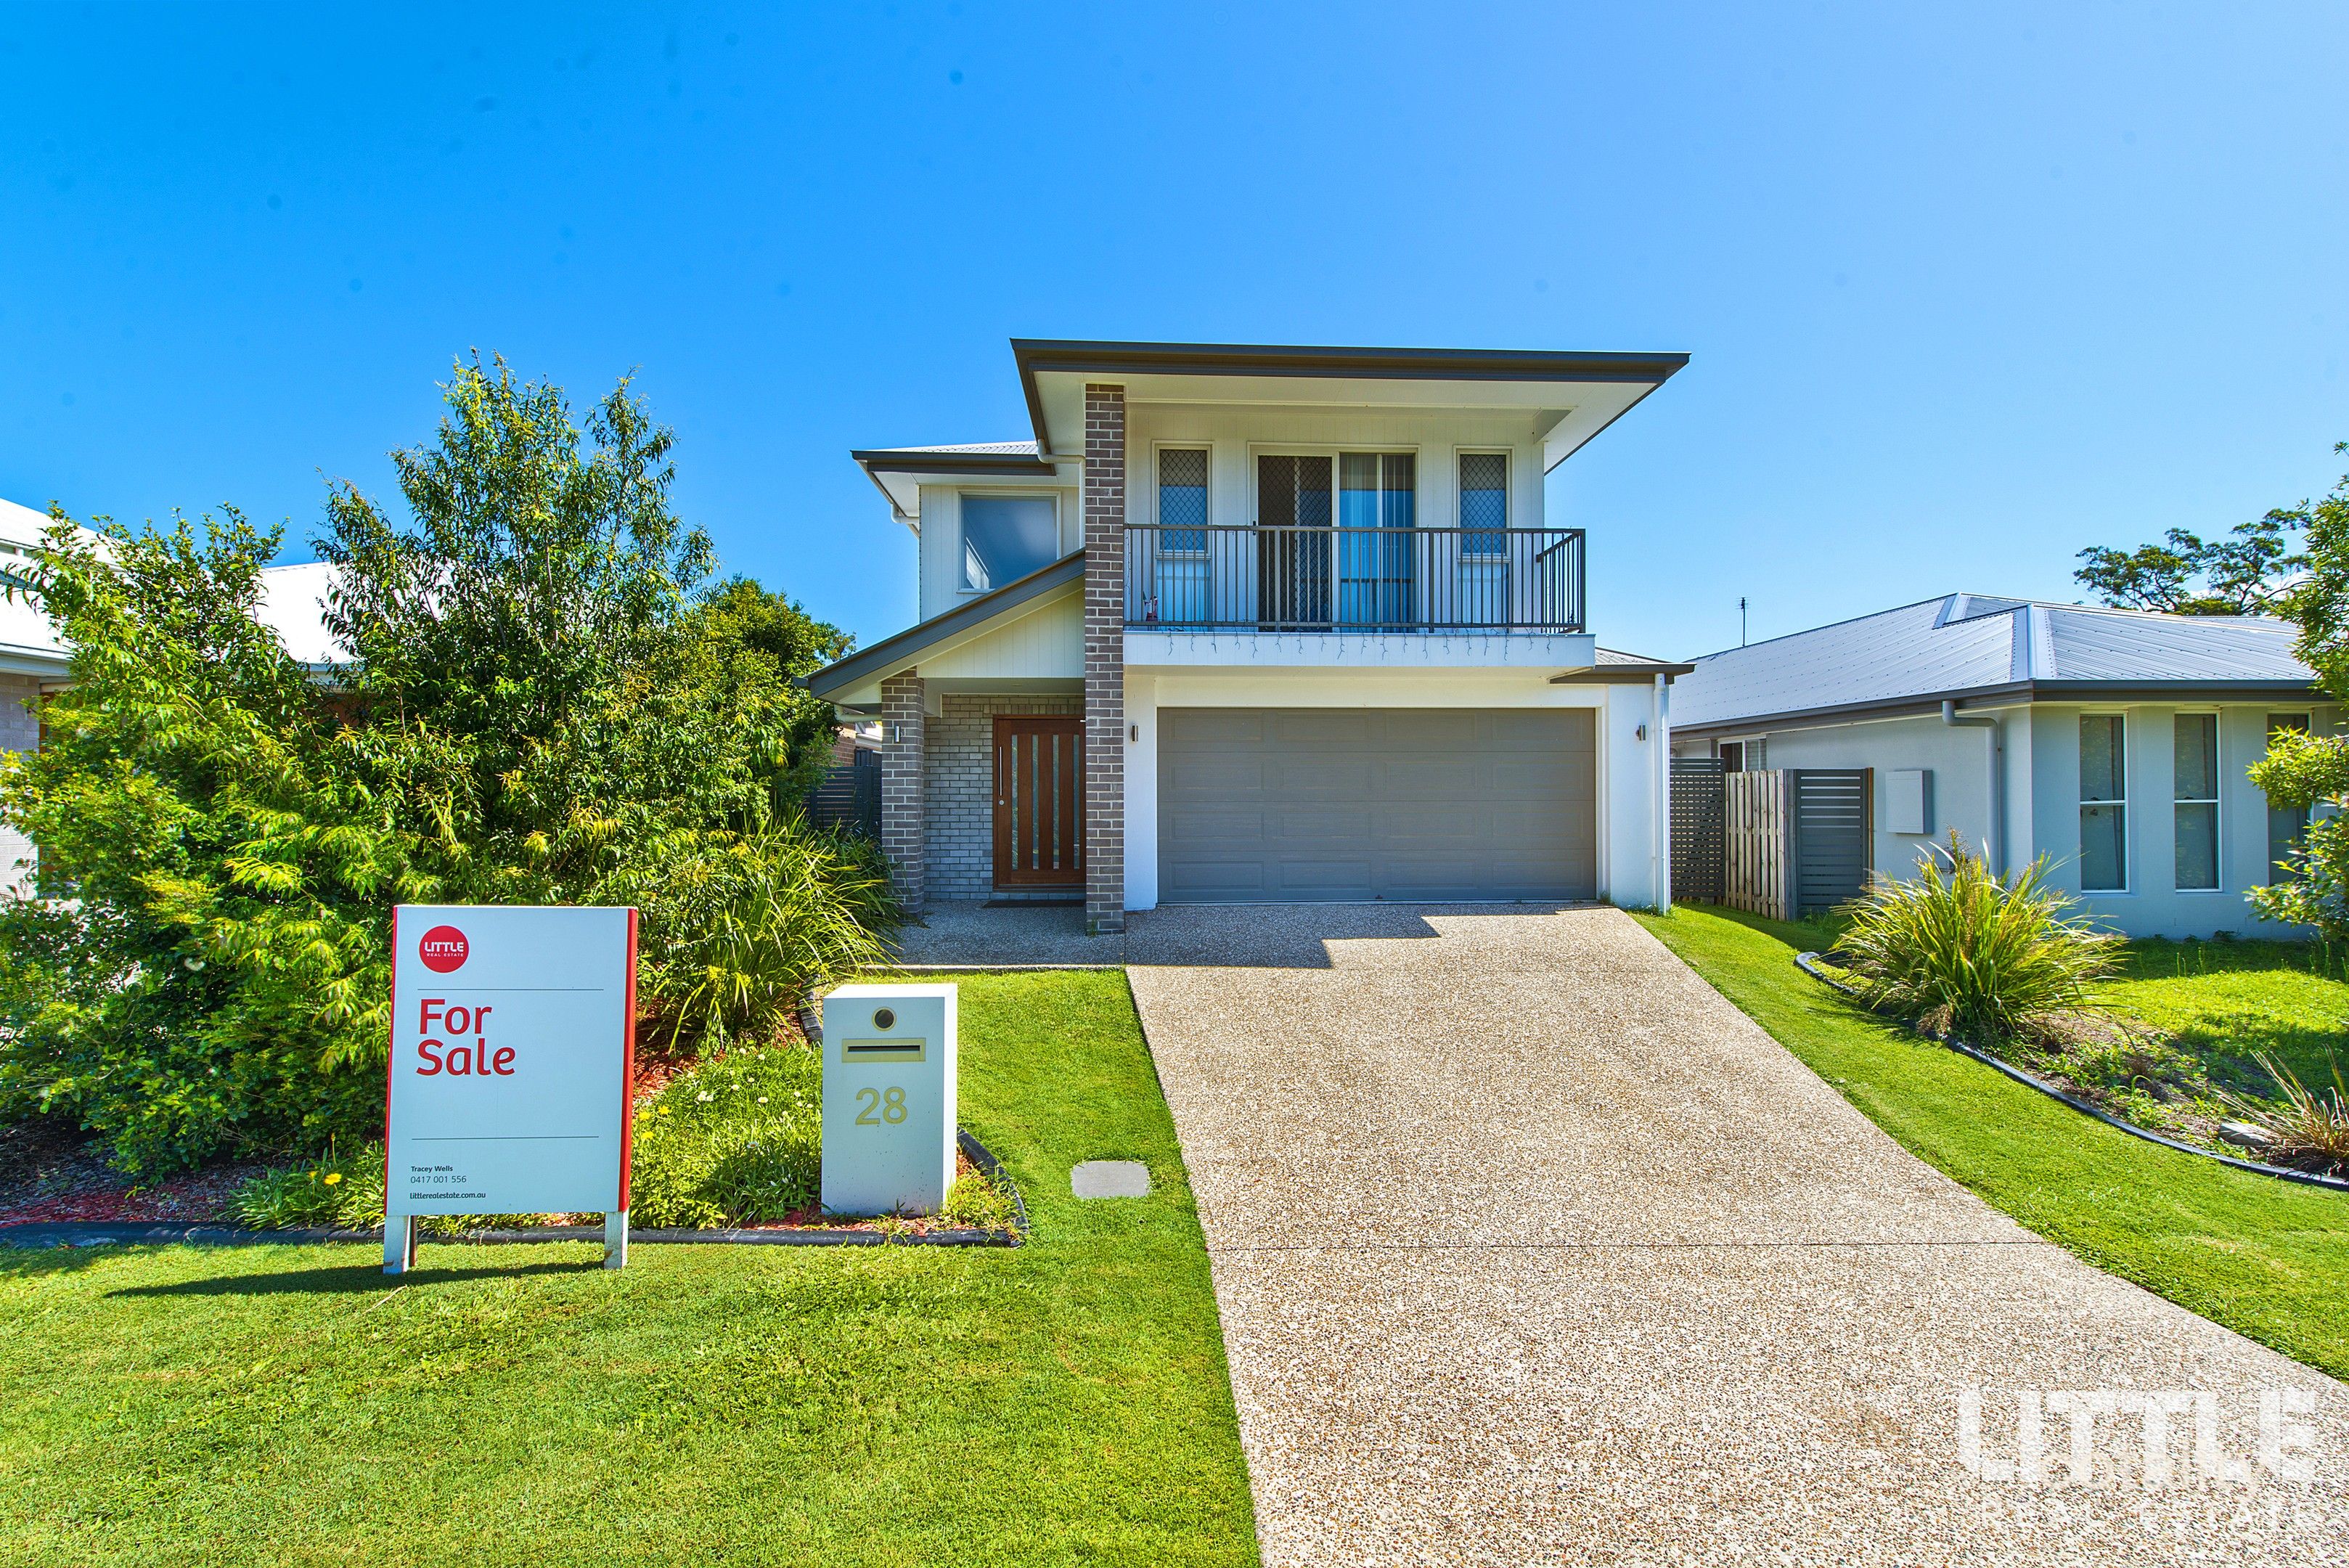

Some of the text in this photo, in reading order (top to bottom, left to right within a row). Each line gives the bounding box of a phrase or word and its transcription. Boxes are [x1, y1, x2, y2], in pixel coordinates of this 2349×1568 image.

[425, 942, 463, 952] LITTLE
[420, 1000, 491, 1034] For
[417, 1038, 515, 1076] Sale
[855, 1087, 907, 1124] 28
